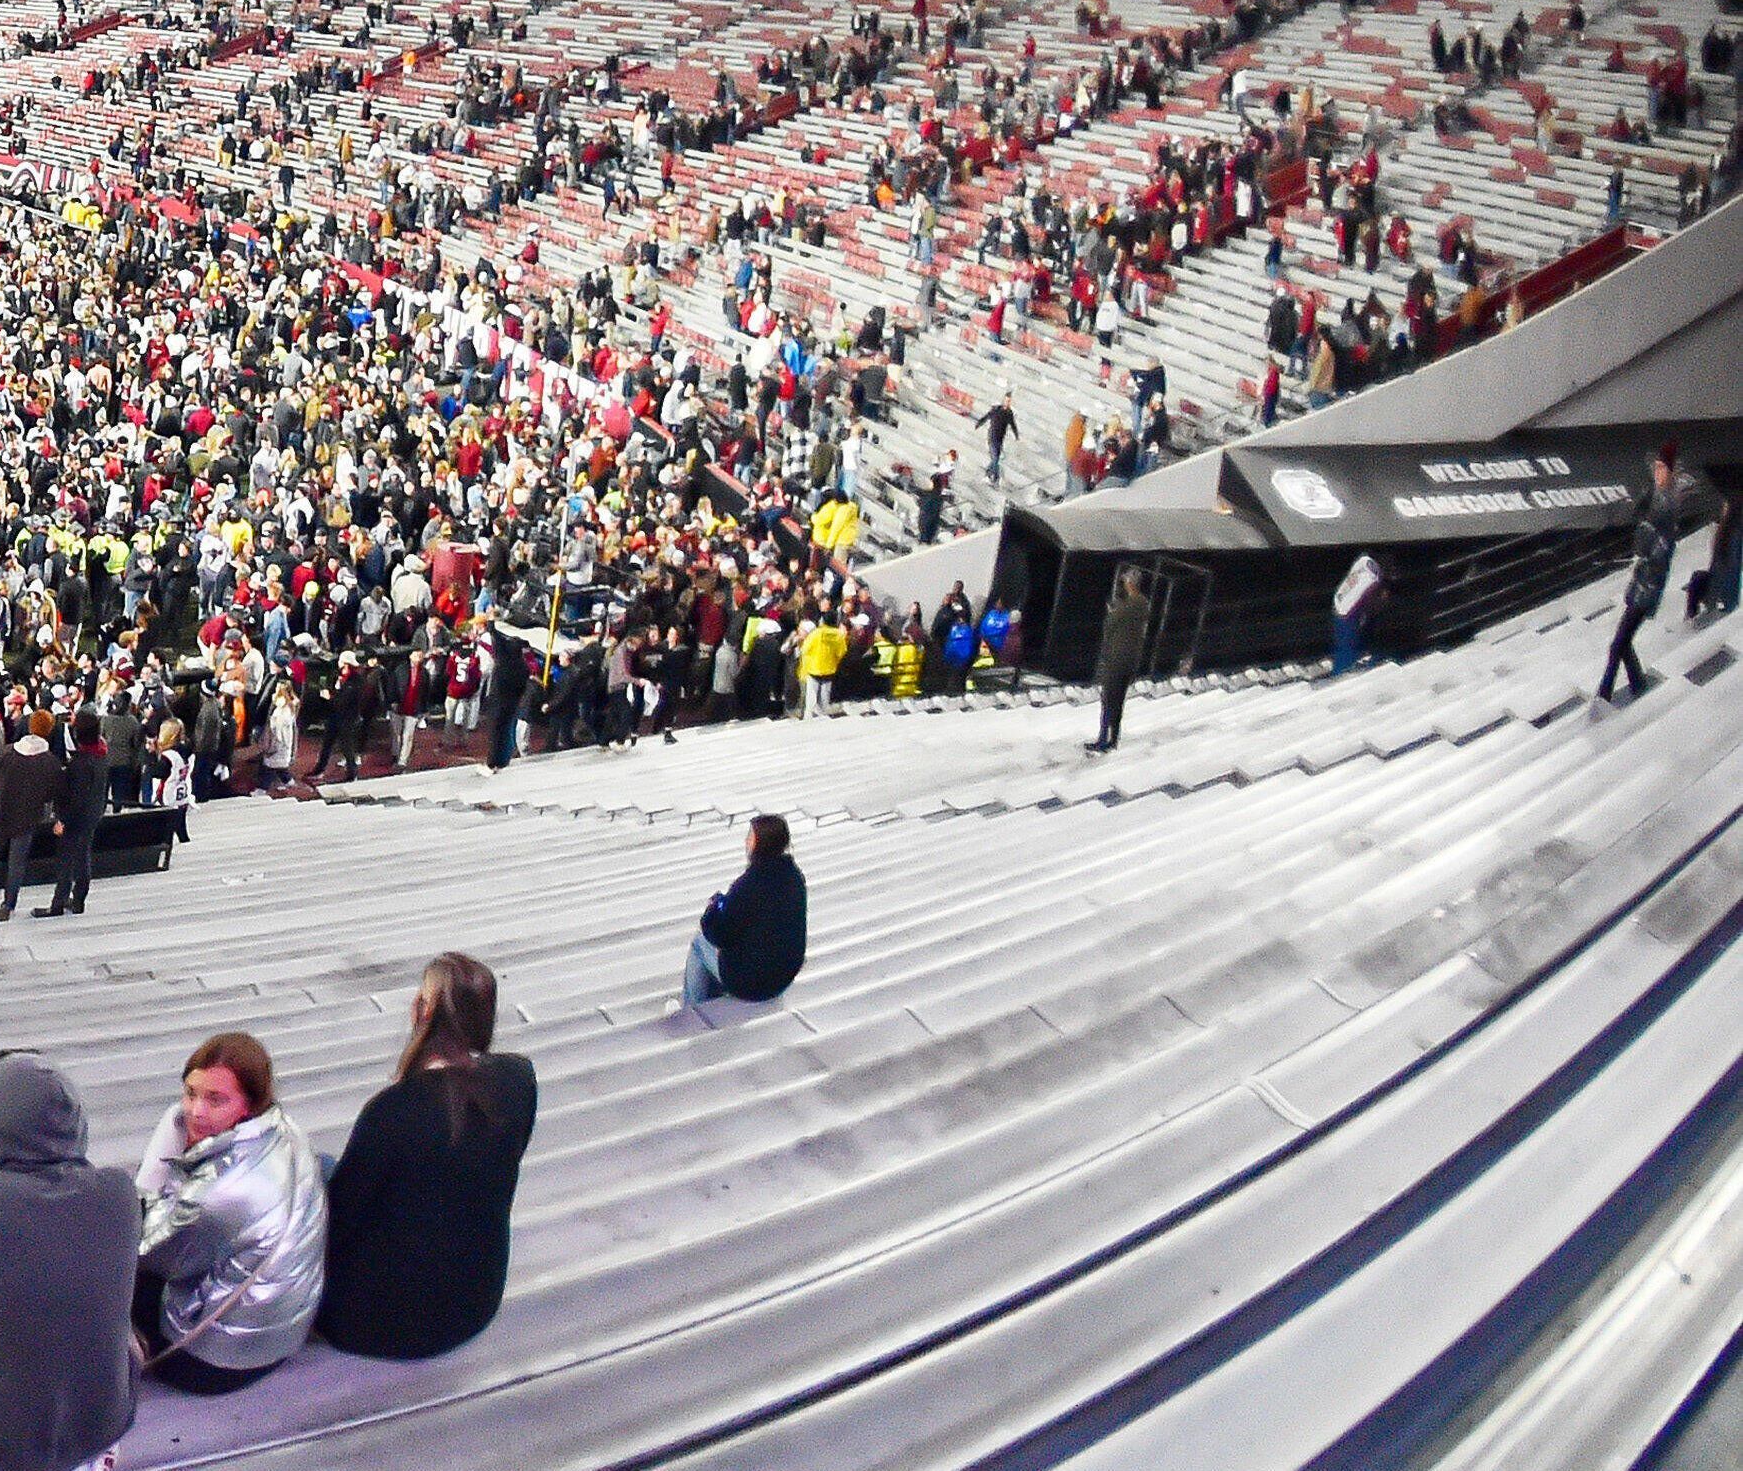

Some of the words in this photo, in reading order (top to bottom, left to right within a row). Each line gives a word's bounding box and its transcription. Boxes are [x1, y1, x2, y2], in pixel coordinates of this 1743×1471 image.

[1420, 459, 1538, 483] WELCOME
[1535, 456, 1572, 476] TO
[1393, 490, 1534, 518] GAMECOCK
[1530, 483, 1633, 510] COUNTRY
[455, 664, 468, 683] 5
